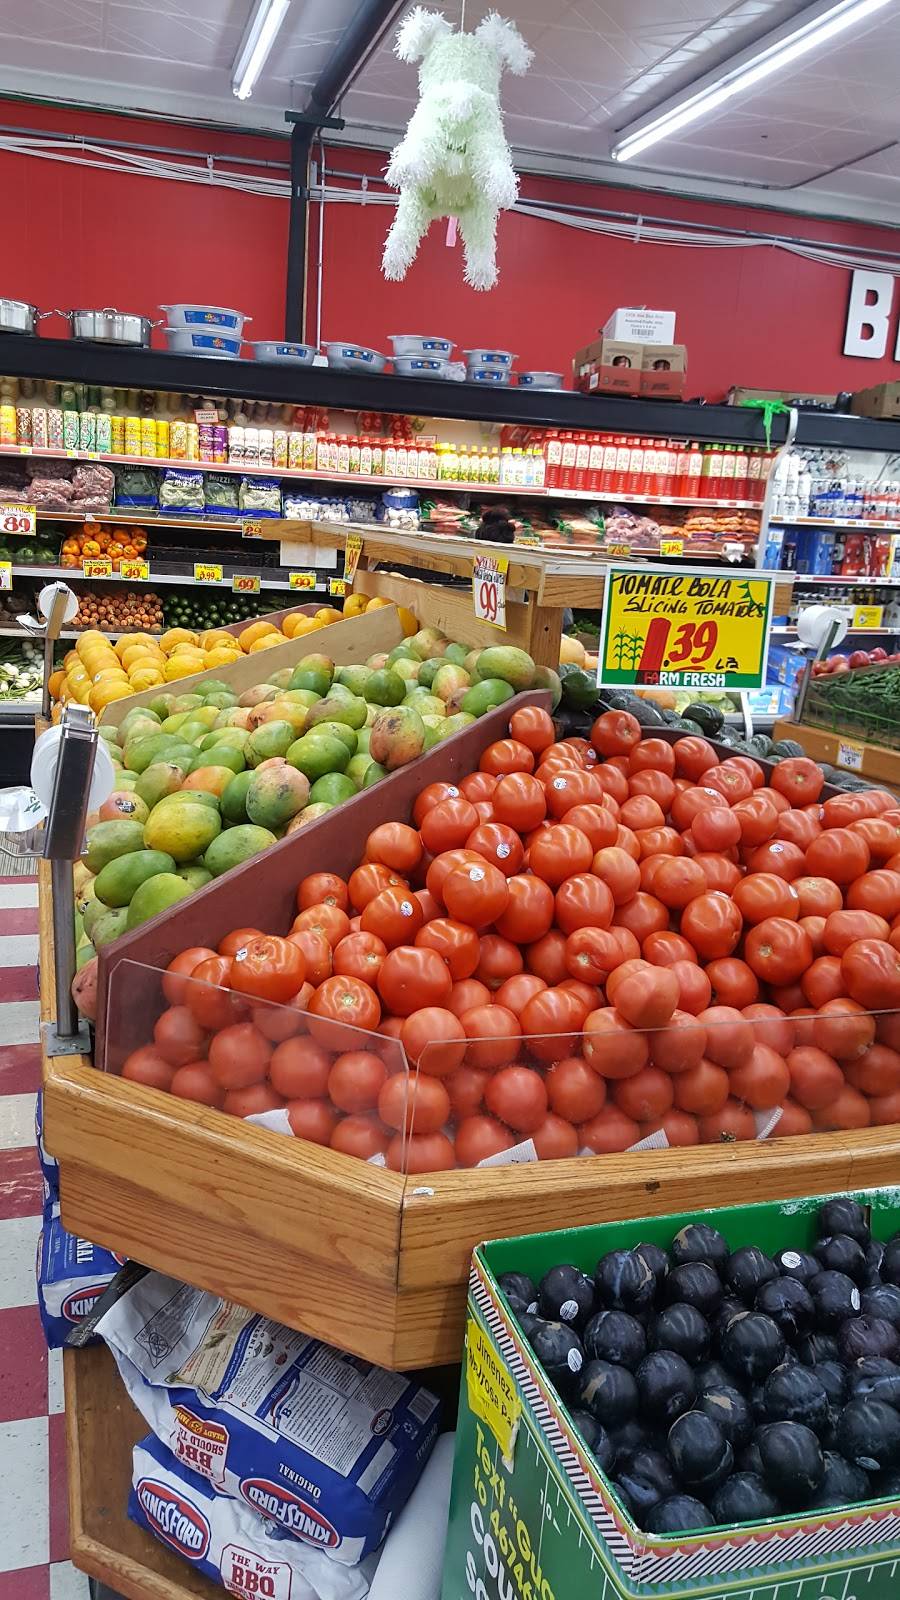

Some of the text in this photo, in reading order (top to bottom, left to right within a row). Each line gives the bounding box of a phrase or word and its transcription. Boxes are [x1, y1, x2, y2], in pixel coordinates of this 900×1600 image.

[844, 270, 900, 361] B
[3, 516, 31, 533] 89
[479, 582, 497, 622] 99
[686, 578, 732, 598] BOLA
[644, 670, 726, 687] FARM FRESH
[70, 1296, 99, 1316] KIN
[190, 1435, 224, 1456] SHOULD
[279, 1462, 322, 1499] ORIGINAL
[476, 1422, 506, 1509] Text
[474, 1464, 487, 1507] to
[141, 1486, 204, 1550] KINGSFORD
[248, 1486, 331, 1544] KINGSFORD
[231, 1551, 281, 1575] THE WAY
[231, 1563, 276, 1599] BBQ
